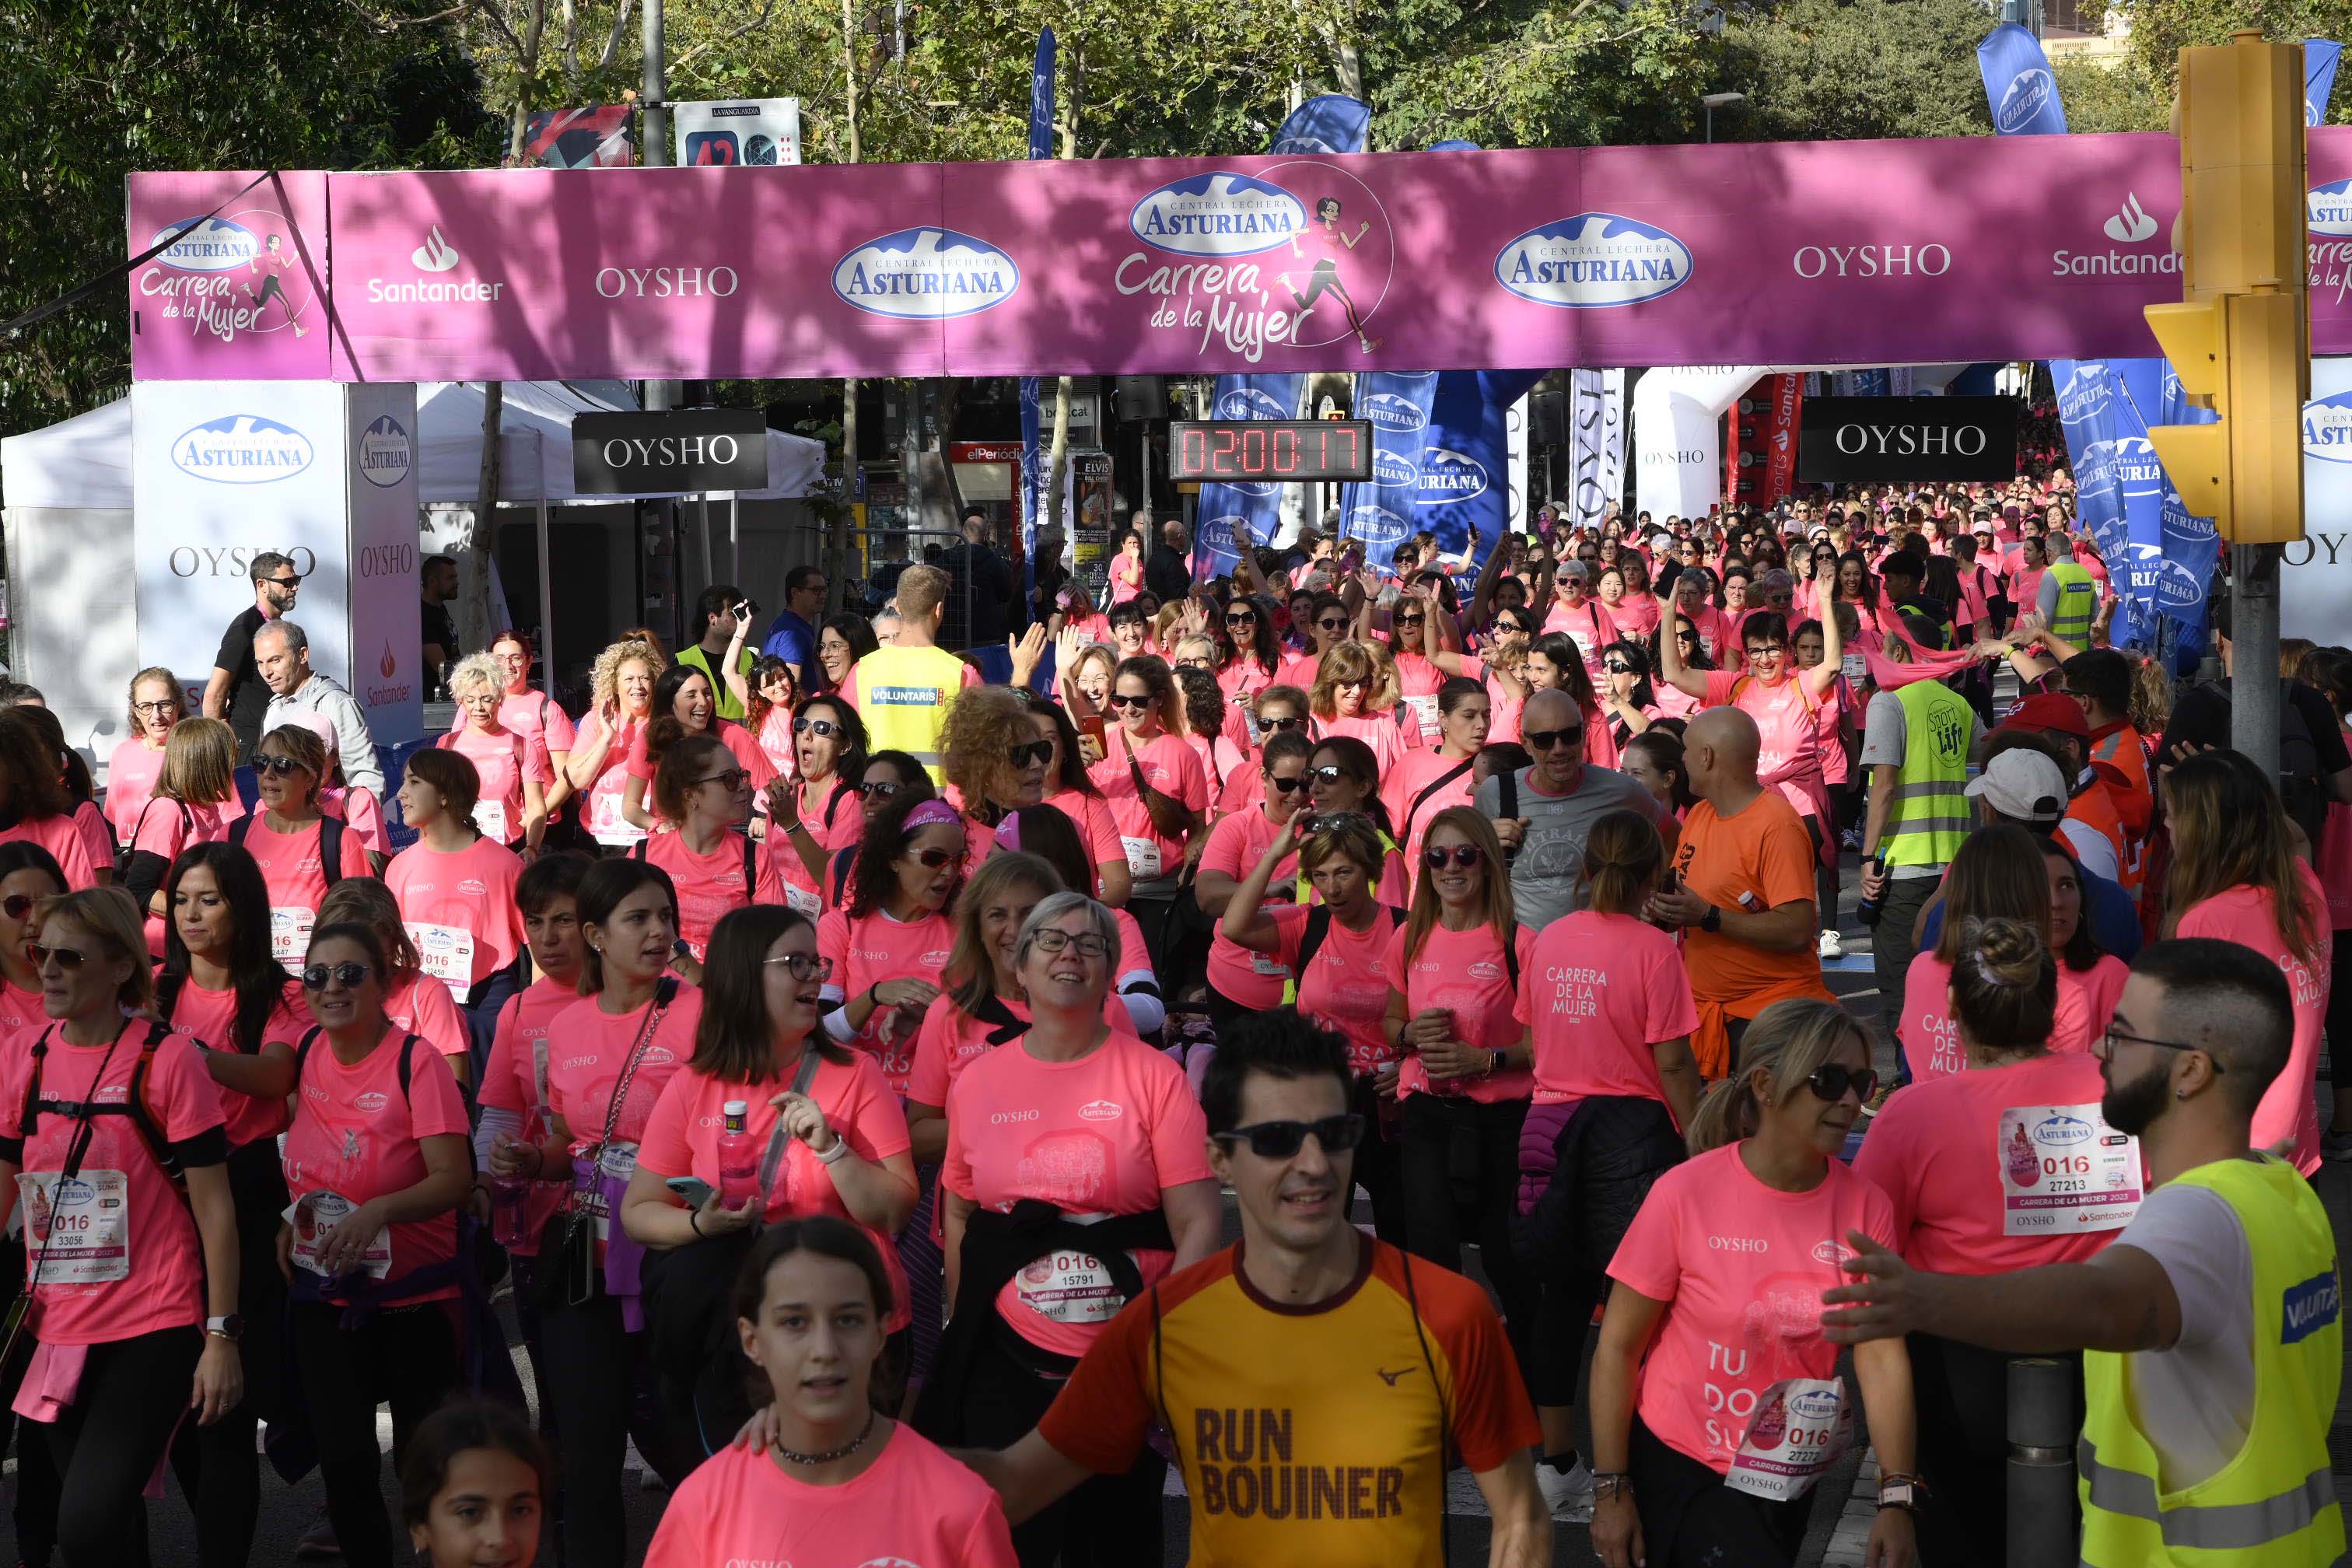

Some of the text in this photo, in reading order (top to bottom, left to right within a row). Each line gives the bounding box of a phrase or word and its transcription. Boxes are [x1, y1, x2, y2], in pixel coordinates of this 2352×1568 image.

[1171, 200, 1288, 210] CENTRAL LECHERA
[1143, 204, 1293, 236] ASTURIANA
[1540, 244, 1671, 256] CENTRAL LECHERA
[875, 257, 999, 268] CENTRAL LECHERA
[1510, 249, 1678, 285] ASTURIANA
[1793, 243, 1951, 278] OYSHO
[140, 268, 231, 296] Carrera
[595, 266, 738, 298] OYSHO
[846, 261, 1004, 296] ASTURIANA
[1115, 252, 1260, 296] Carrera
[368, 279, 503, 303] Santander
[163, 294, 266, 342] de la Mujer
[1150, 289, 1314, 363] de la Mujer
[1836, 424, 1986, 456] OYSHO
[183, 440, 304, 467] ASTURIANA
[363, 443, 408, 470] ASTURIANA
[603, 435, 739, 468] OYSHO
[1645, 450, 1704, 464] OYSHO
[1085, 464, 1109, 473] ELVIS
[1374, 467, 1412, 481] URIANA
[1419, 474, 1481, 491] URIANA
[169, 546, 317, 578] OYSO
[360, 543, 413, 577] OYSHO
[1094, 563, 1103, 572] 30
[367, 681, 411, 708] Santander
[872, 690, 936, 702] VOLUNTARIS
[1929, 705, 1958, 733] Sport
[275, 936, 292, 946] 16
[425, 954, 449, 967] 016
[426, 968, 445, 976] 22450
[1545, 966, 1608, 986] CARRERA
[1556, 983, 1594, 999] DE LA
[1551, 999, 1597, 1017] MUJER
[523, 1027, 547, 1037] OYS
[1934, 1034, 1957, 1055] DE
[562, 1055, 597, 1071] OYSHO
[990, 1108, 1040, 1125] OYSHO
[1081, 1108, 1121, 1117] ASTURIANA
[2038, 1128, 2089, 1140] ASTURIANA
[2043, 1155, 2090, 1175] 016
[2049, 1179, 2086, 1192] 27213
[54, 1215, 89, 1231] 016
[2017, 1216, 2055, 1226] OYSHO
[2089, 1211, 2133, 1222] Santander
[58, 1236, 83, 1246] 33056
[1708, 1236, 1768, 1253] OYSHO
[80, 1265, 119, 1274] Santander
[1057, 1255, 1098, 1271] 016
[1062, 1275, 1094, 1286] 15791
[1031, 1292, 1065, 1300] CARRERA
[1706, 1339, 1747, 1376] TU
[1195, 1408, 1293, 1464] RUN
[1790, 1427, 1830, 1446] 016
[1748, 1460, 1787, 1473] CARRERA
[1199, 1464, 1404, 1520] BOUINER
[1740, 1475, 1783, 1492] OYSHO
